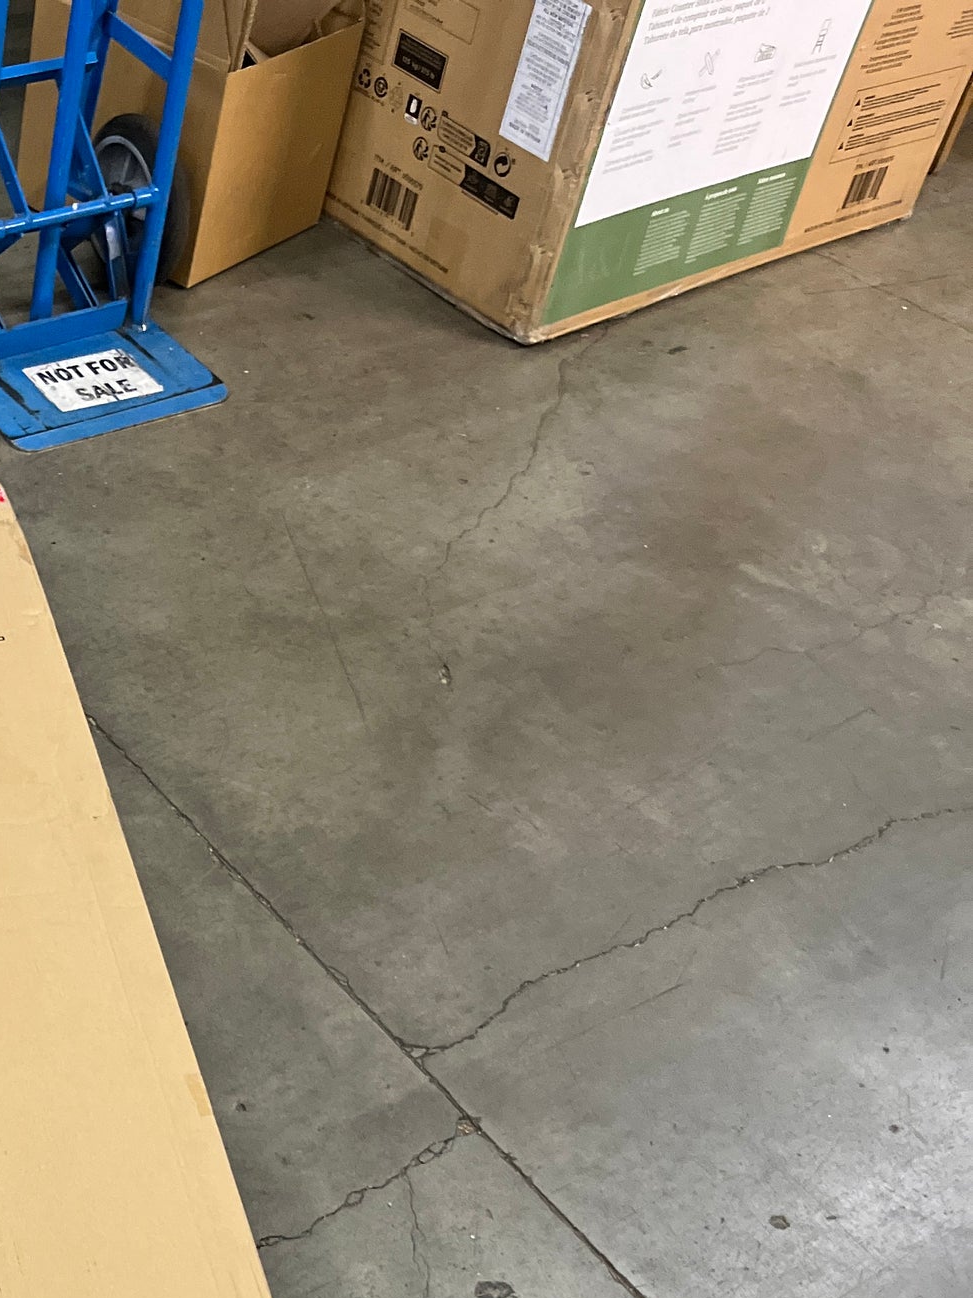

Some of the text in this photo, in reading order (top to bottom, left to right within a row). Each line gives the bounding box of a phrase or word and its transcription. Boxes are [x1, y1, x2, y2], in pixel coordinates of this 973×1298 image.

[36, 356, 136, 385] NOT FOR
[75, 378, 138, 401] SALE
